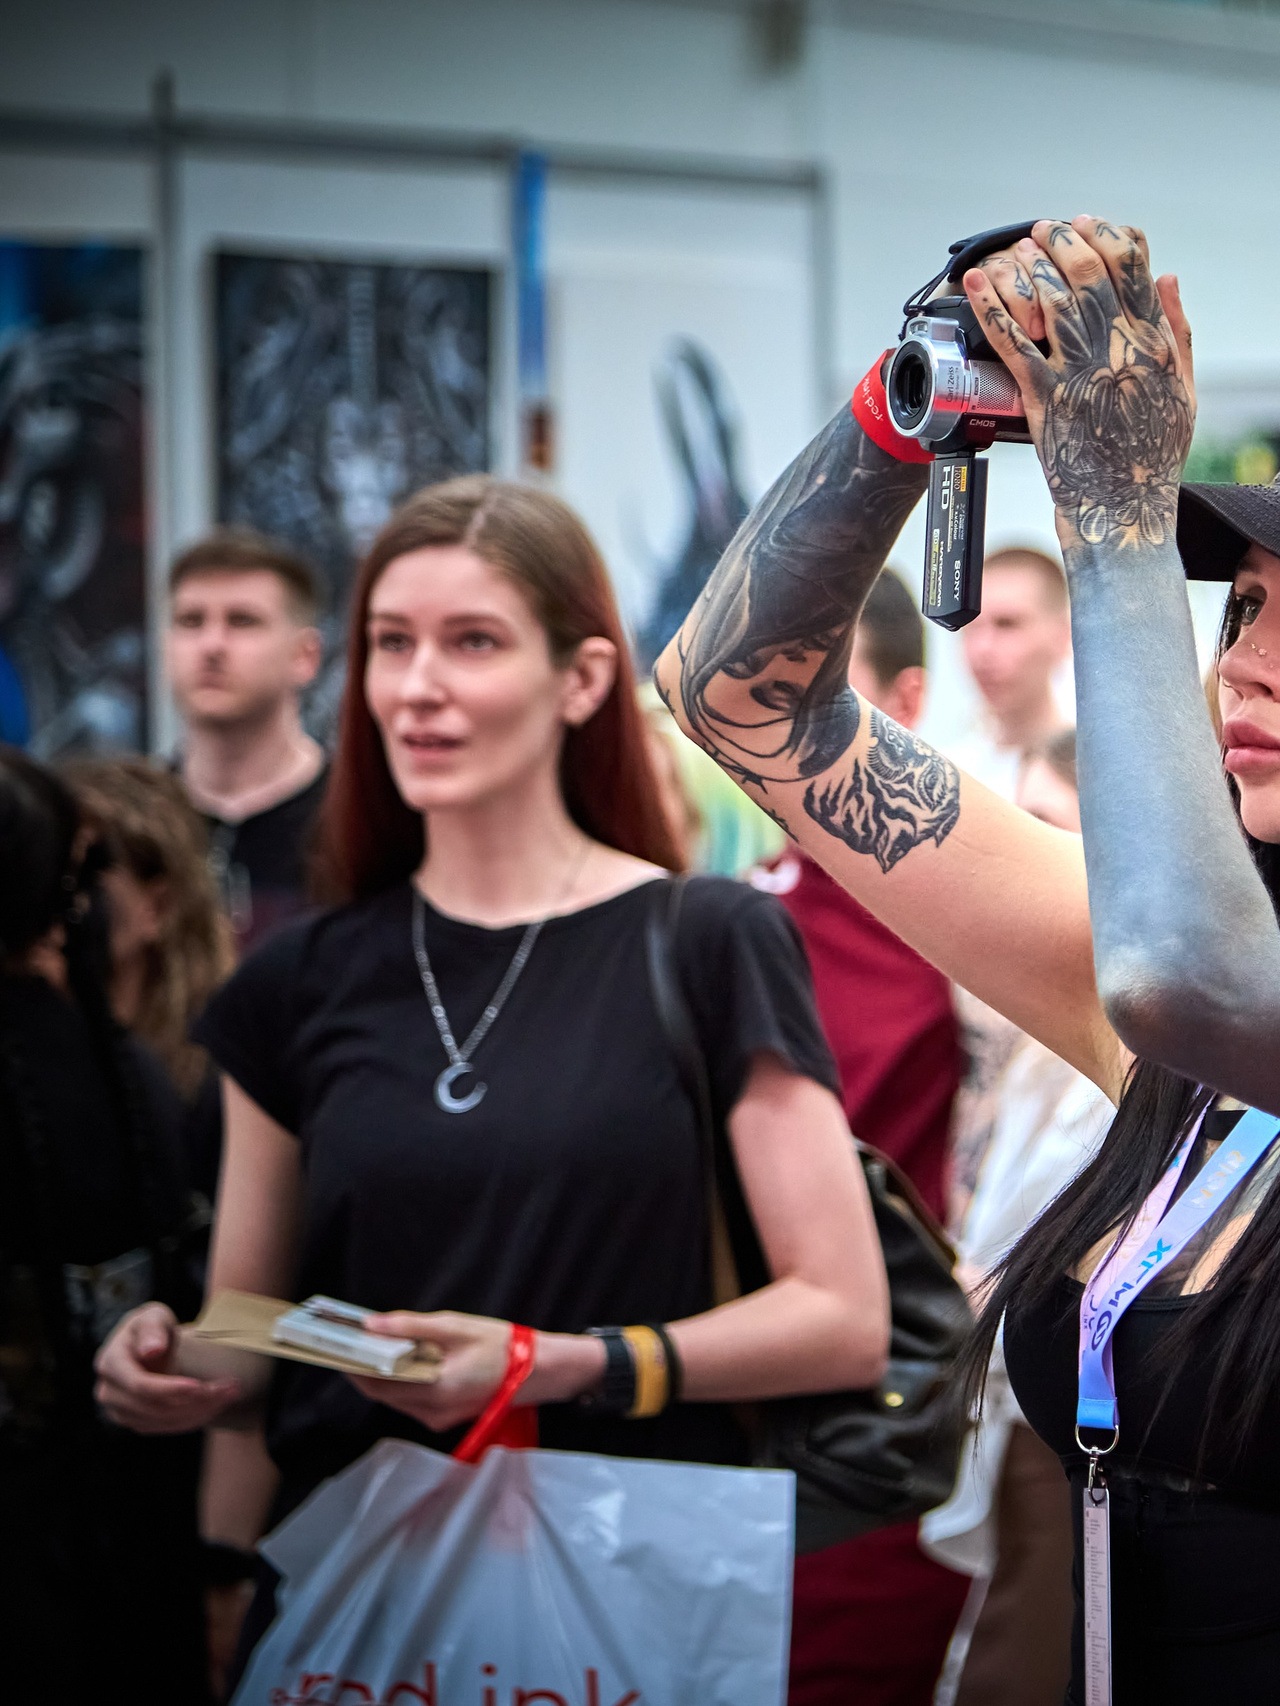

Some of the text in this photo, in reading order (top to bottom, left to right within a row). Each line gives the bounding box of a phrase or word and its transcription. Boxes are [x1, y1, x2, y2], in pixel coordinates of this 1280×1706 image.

[946, 387, 954, 402] Carl
[865, 396, 883, 421] red
[969, 418, 996, 428] CMOS
[941, 465, 951, 510] HD
[953, 560, 961, 601] SONY
